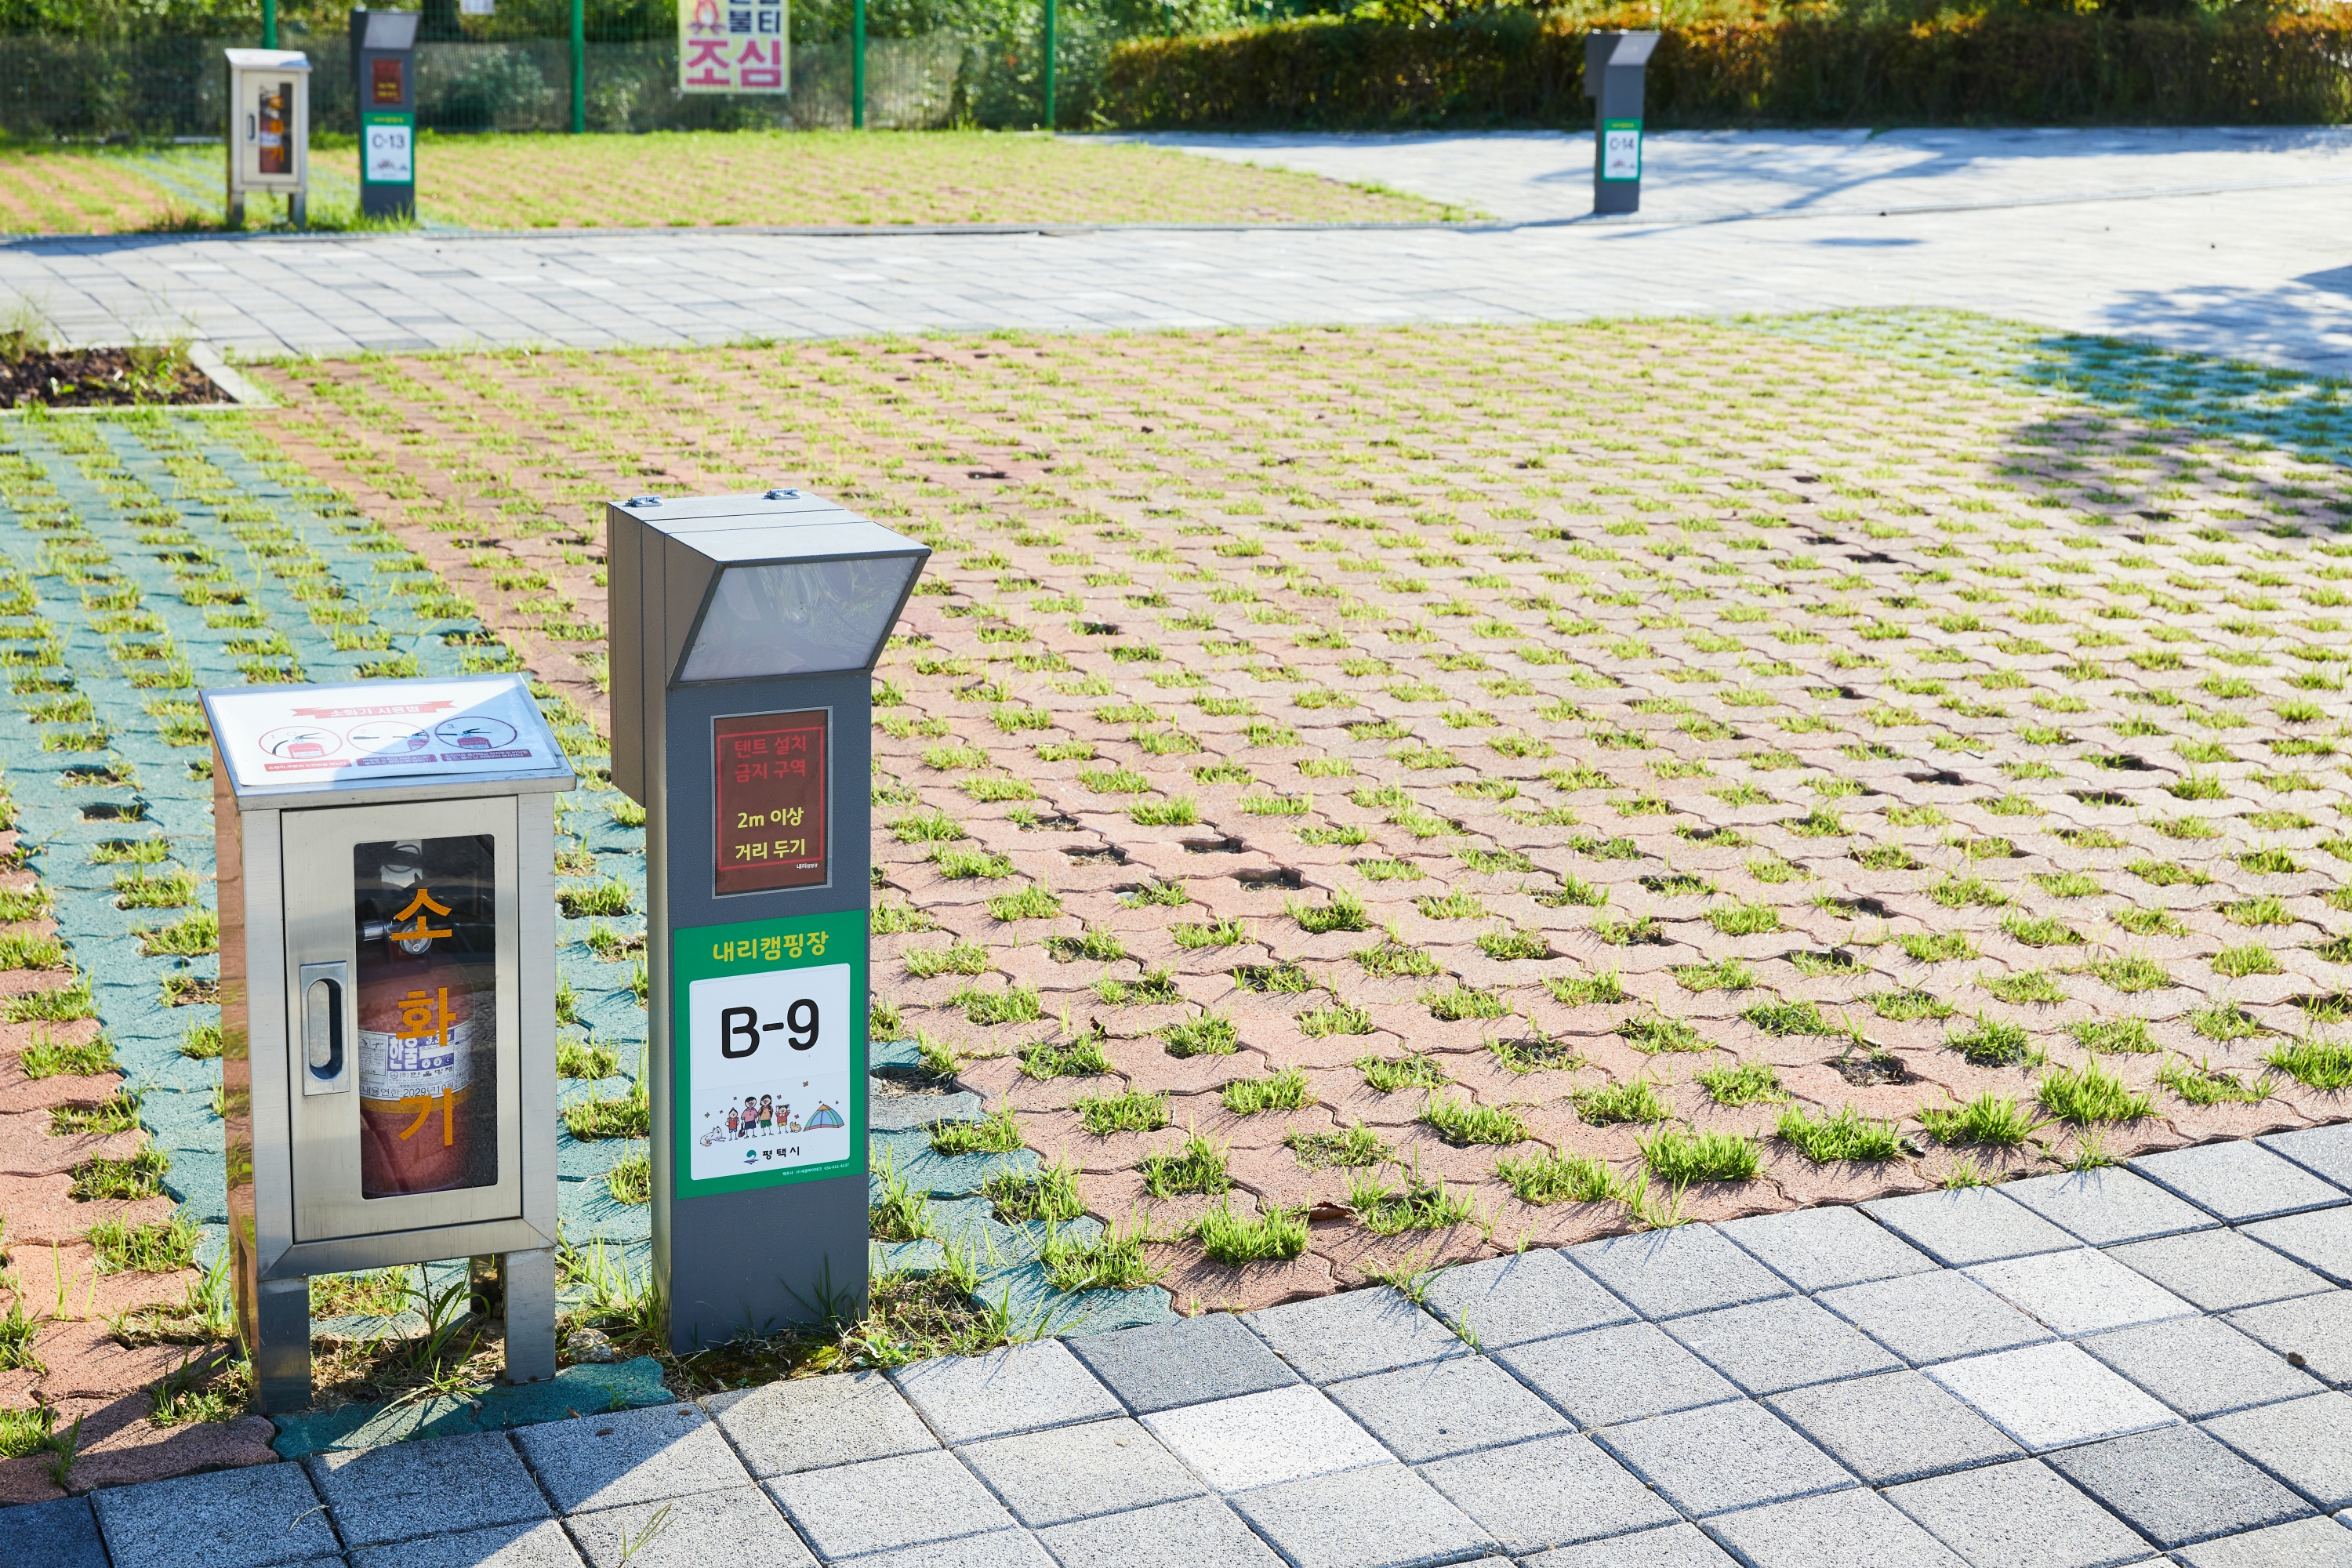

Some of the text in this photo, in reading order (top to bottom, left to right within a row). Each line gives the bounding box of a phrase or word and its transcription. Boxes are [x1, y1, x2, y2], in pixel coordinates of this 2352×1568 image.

[730, 10, 780, 33] 불티
[686, 40, 781, 87] 조심
[372, 132, 405, 150] C-13
[1610, 136, 1634, 151] C-14
[331, 706, 420, 717] 소화기 사용법
[735, 735, 806, 759] 텐트 설치
[735, 759, 806, 783] 금지 구역
[737, 807, 804, 829] 2m 이상
[735, 838, 805, 861] 거리 두기
[713, 931, 829, 963] 내리캠핑장
[390, 887, 456, 1146] 소화기
[721, 998, 819, 1059] B-9
[762, 1145, 800, 1161] 평택시
